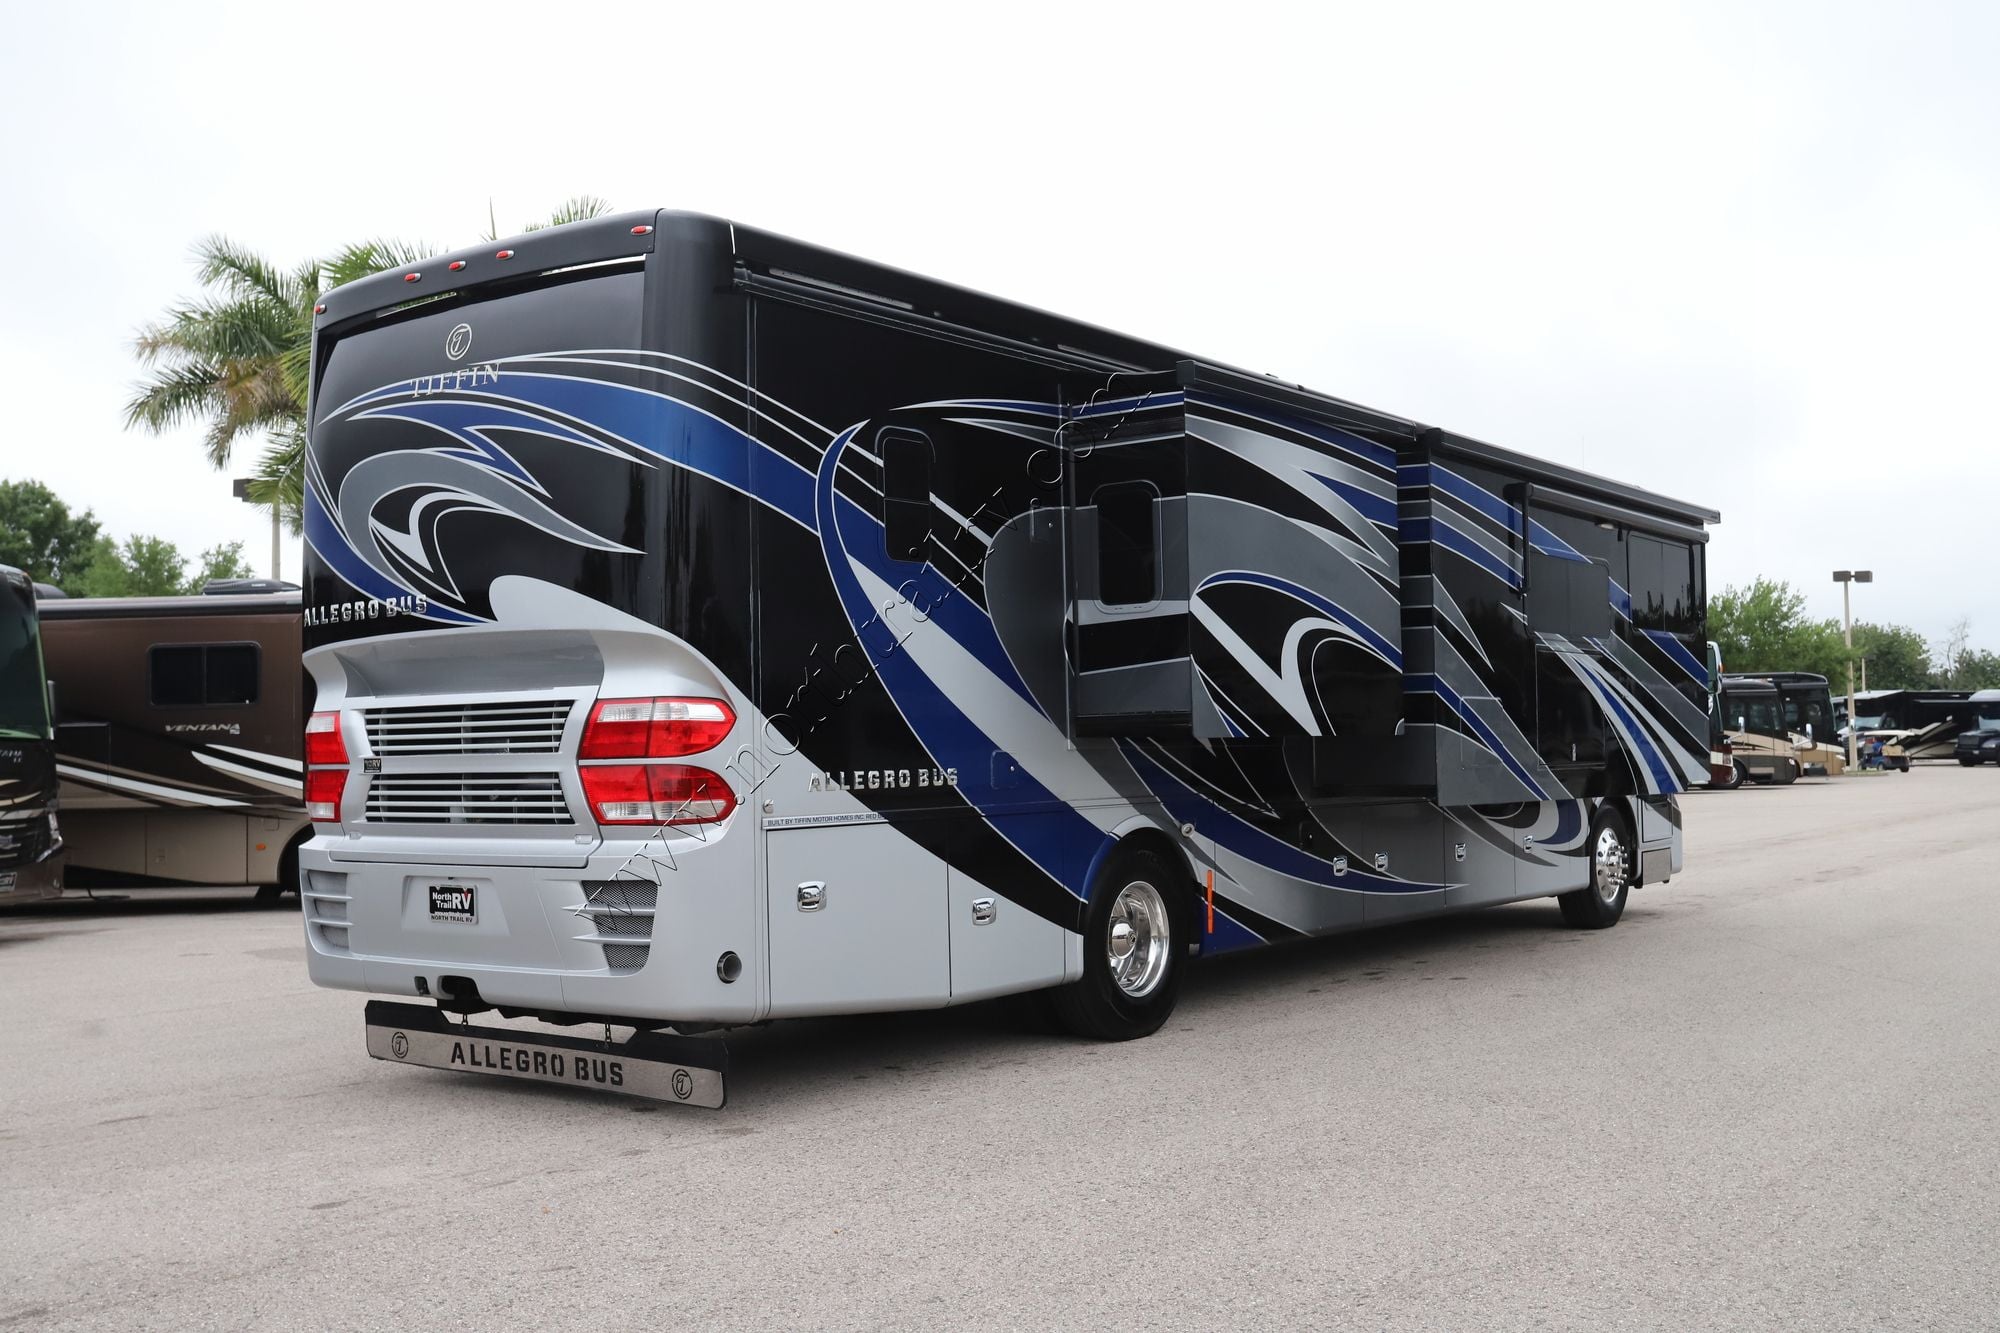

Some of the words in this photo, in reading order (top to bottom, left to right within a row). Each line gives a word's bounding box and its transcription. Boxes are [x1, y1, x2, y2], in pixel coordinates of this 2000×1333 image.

[410, 362, 500, 398] TIFFIN
[303, 600, 379, 627] ALLEGRO
[386, 594, 427, 617] BUS
[165, 723, 240, 731] VENTANA
[808, 769, 911, 793] ALLEGRO
[918, 767, 958, 788] BUS
[432, 891, 451, 900] North
[436, 900, 451, 908] Trail
[452, 892, 472, 909] RV
[450, 1042, 565, 1077] ALLEGRO
[574, 1056, 624, 1087] BUS
